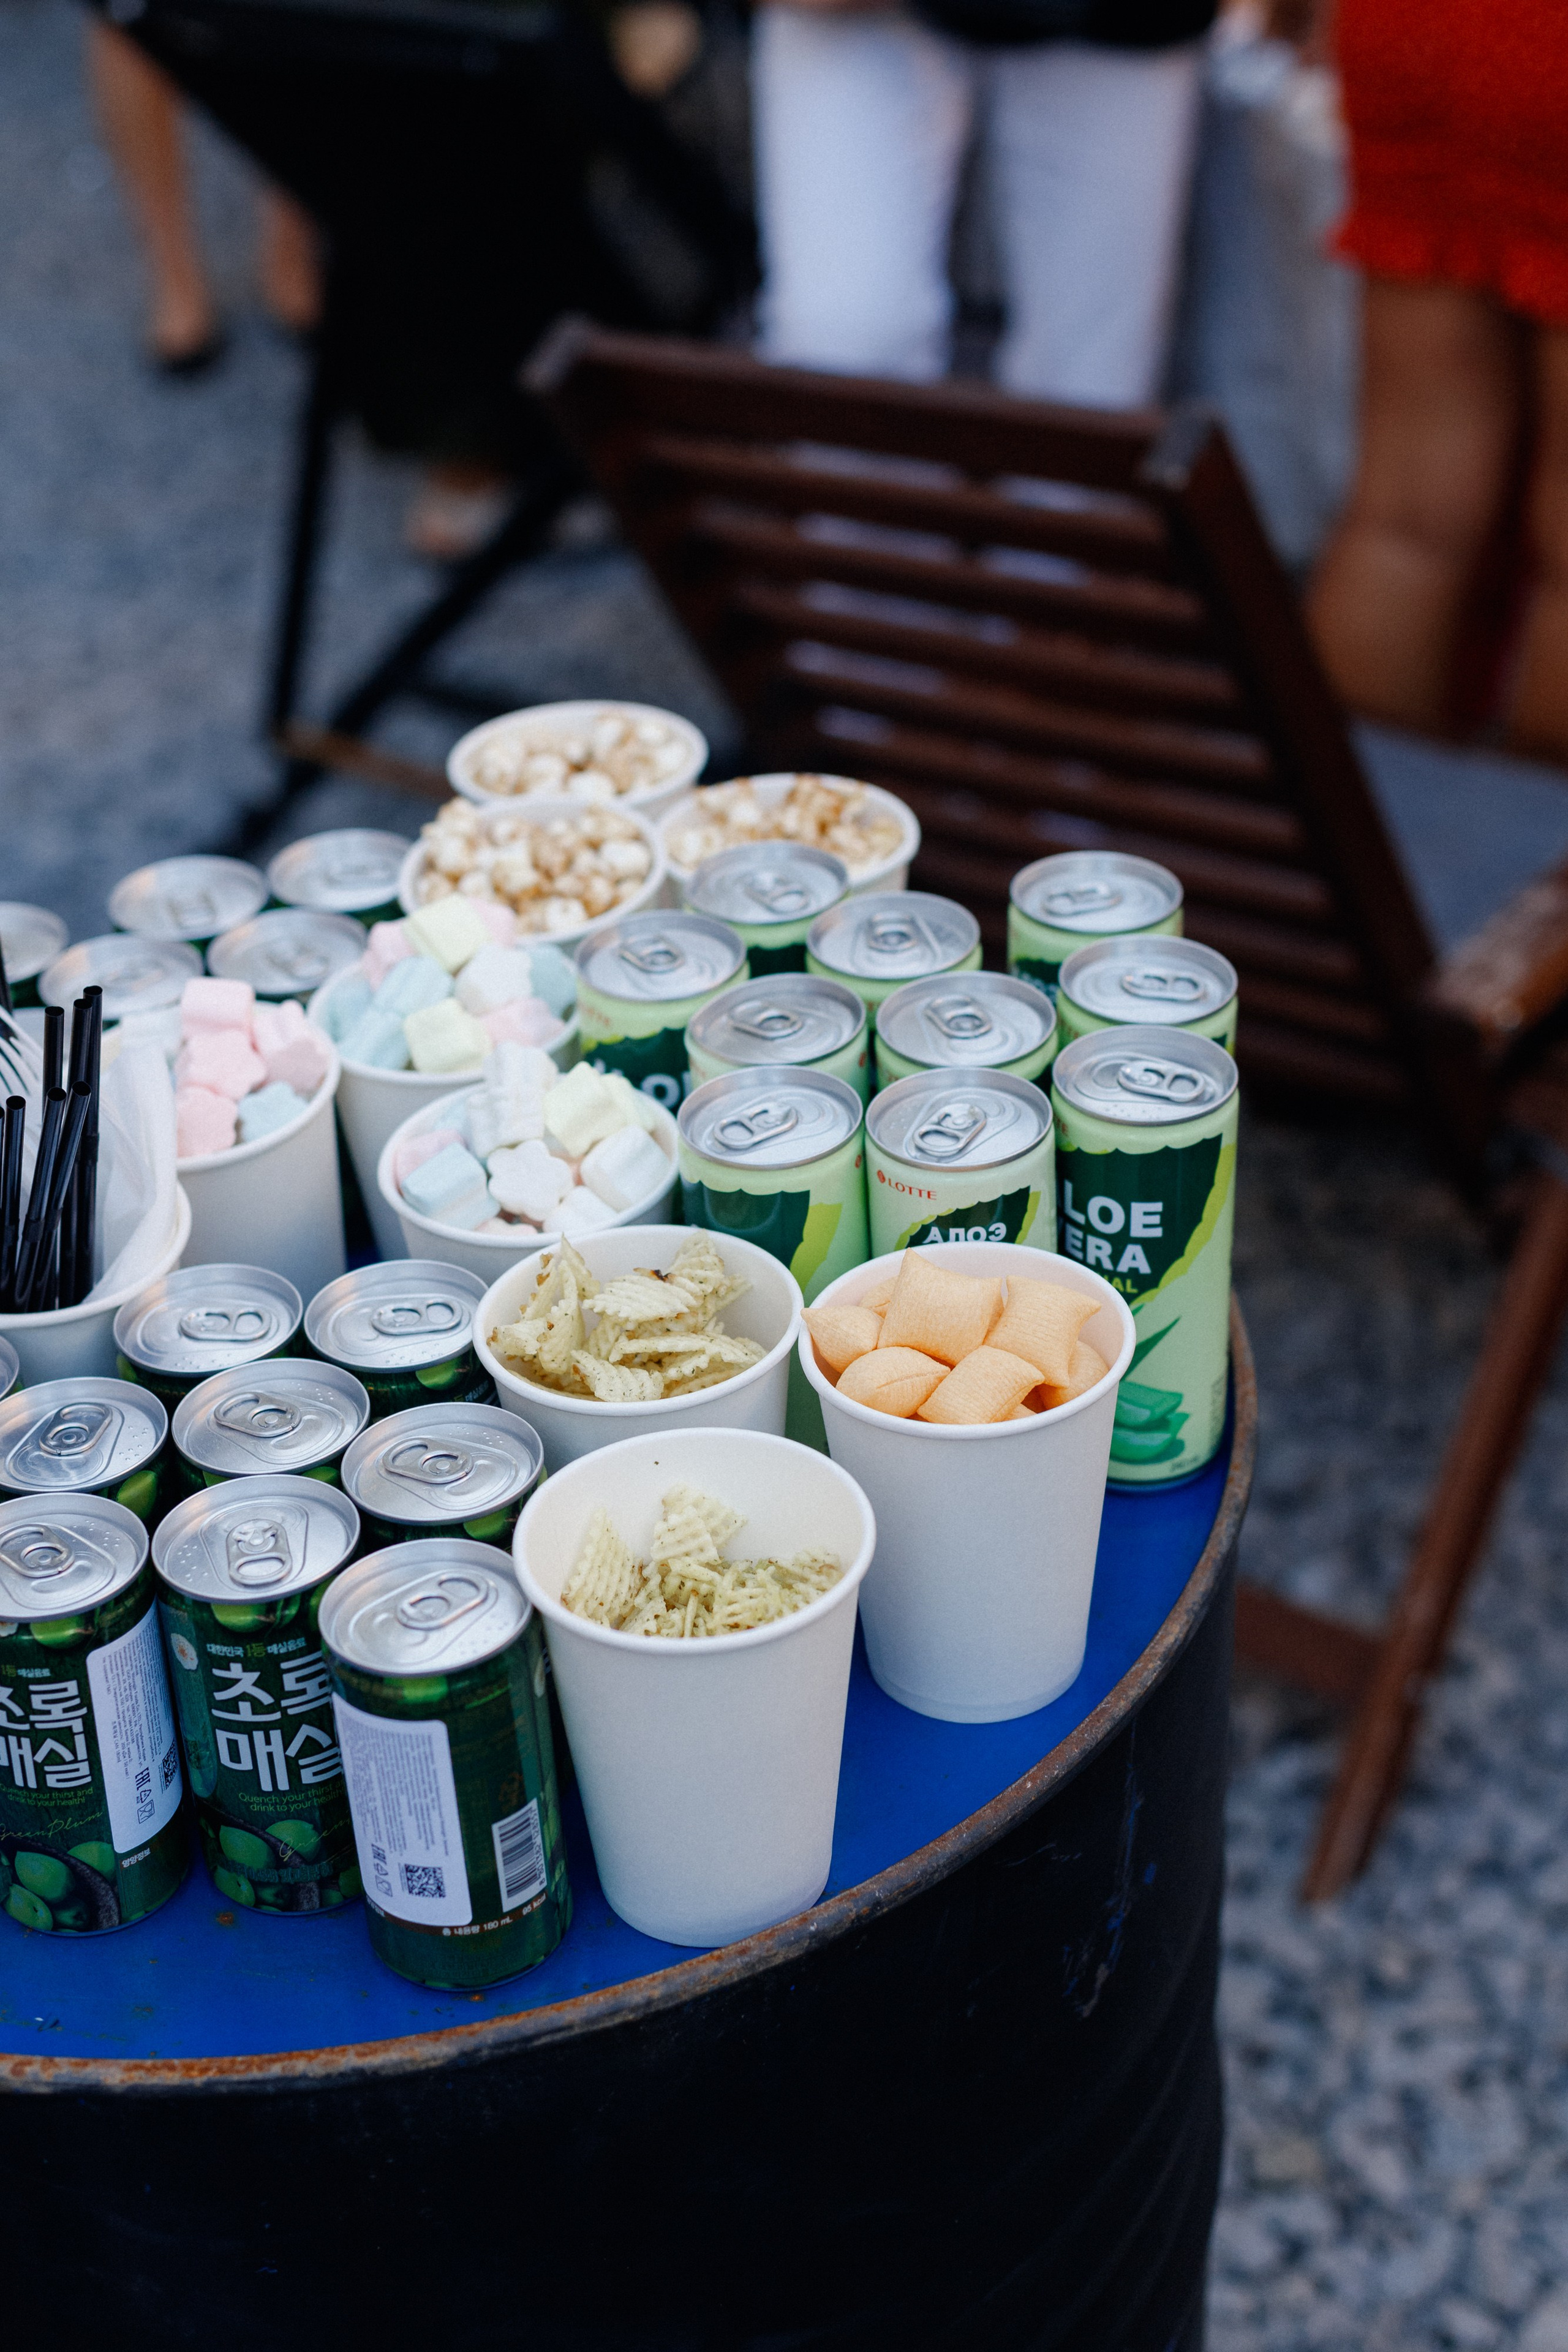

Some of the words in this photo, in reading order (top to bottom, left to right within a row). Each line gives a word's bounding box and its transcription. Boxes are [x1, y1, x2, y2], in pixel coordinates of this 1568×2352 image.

[888, 1178, 937, 1200] LOTTE
[1063, 1178, 1163, 1238] LOE
[1064, 1224, 1152, 1275] ERA
[211, 1649, 333, 1722] 초록
[77, 1786, 94, 1795] and
[238, 1792, 279, 1804] Quench
[282, 1793, 305, 1804] your
[307, 1784, 334, 1798] thirst
[37, 1799, 56, 1807] your
[250, 1803, 275, 1812] drink
[288, 1800, 313, 1812] your
[122, 1847, 151, 1868] 영양정보
[532, 1893, 547, 1910] kcal
[500, 1915, 514, 1926] mL
